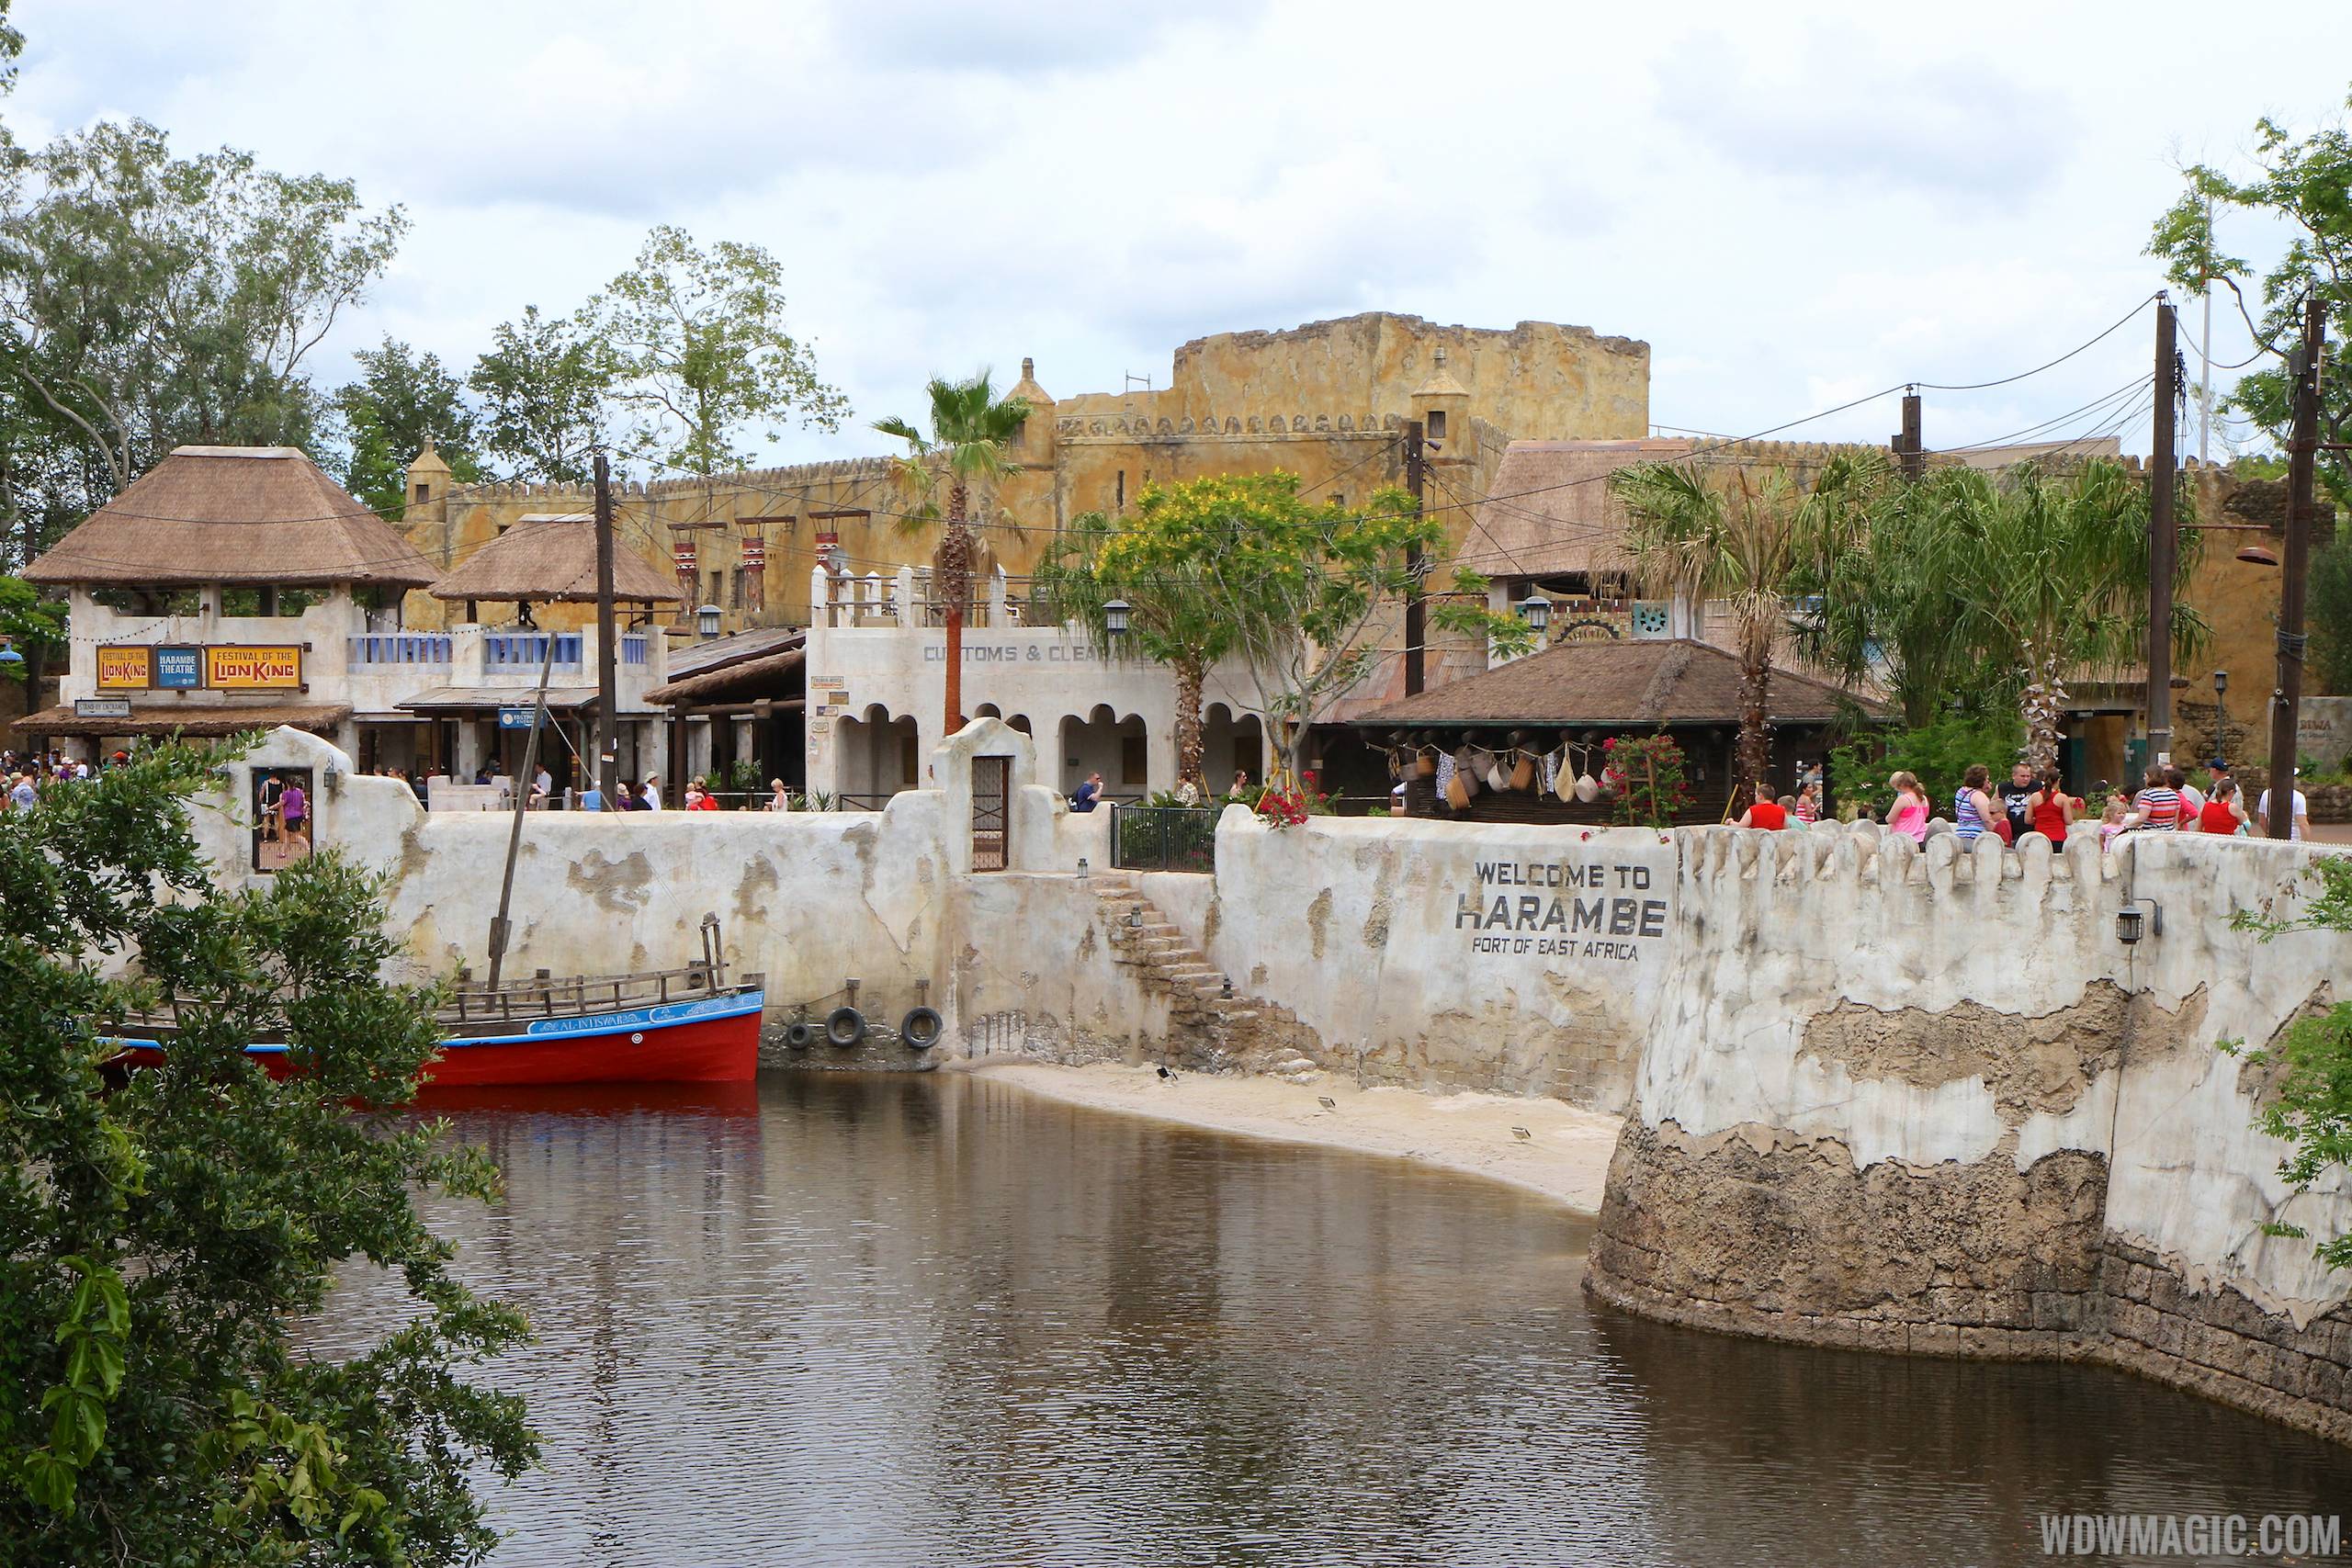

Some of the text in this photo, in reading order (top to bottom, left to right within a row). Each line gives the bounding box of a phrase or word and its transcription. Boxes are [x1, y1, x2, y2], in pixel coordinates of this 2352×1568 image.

[159, 656, 196, 664] HARAMBE
[217, 651, 292, 660] FESTIVAL OF THE
[923, 647, 1017, 661] CUTOMS
[1026, 645, 1041, 661] &
[160, 665, 195, 673] THEATRE
[1476, 862, 1650, 890] WELCOME TO
[1455, 893, 1667, 938] HARAMBE
[1472, 937, 1639, 962] PORT OF EAST AFRICA
